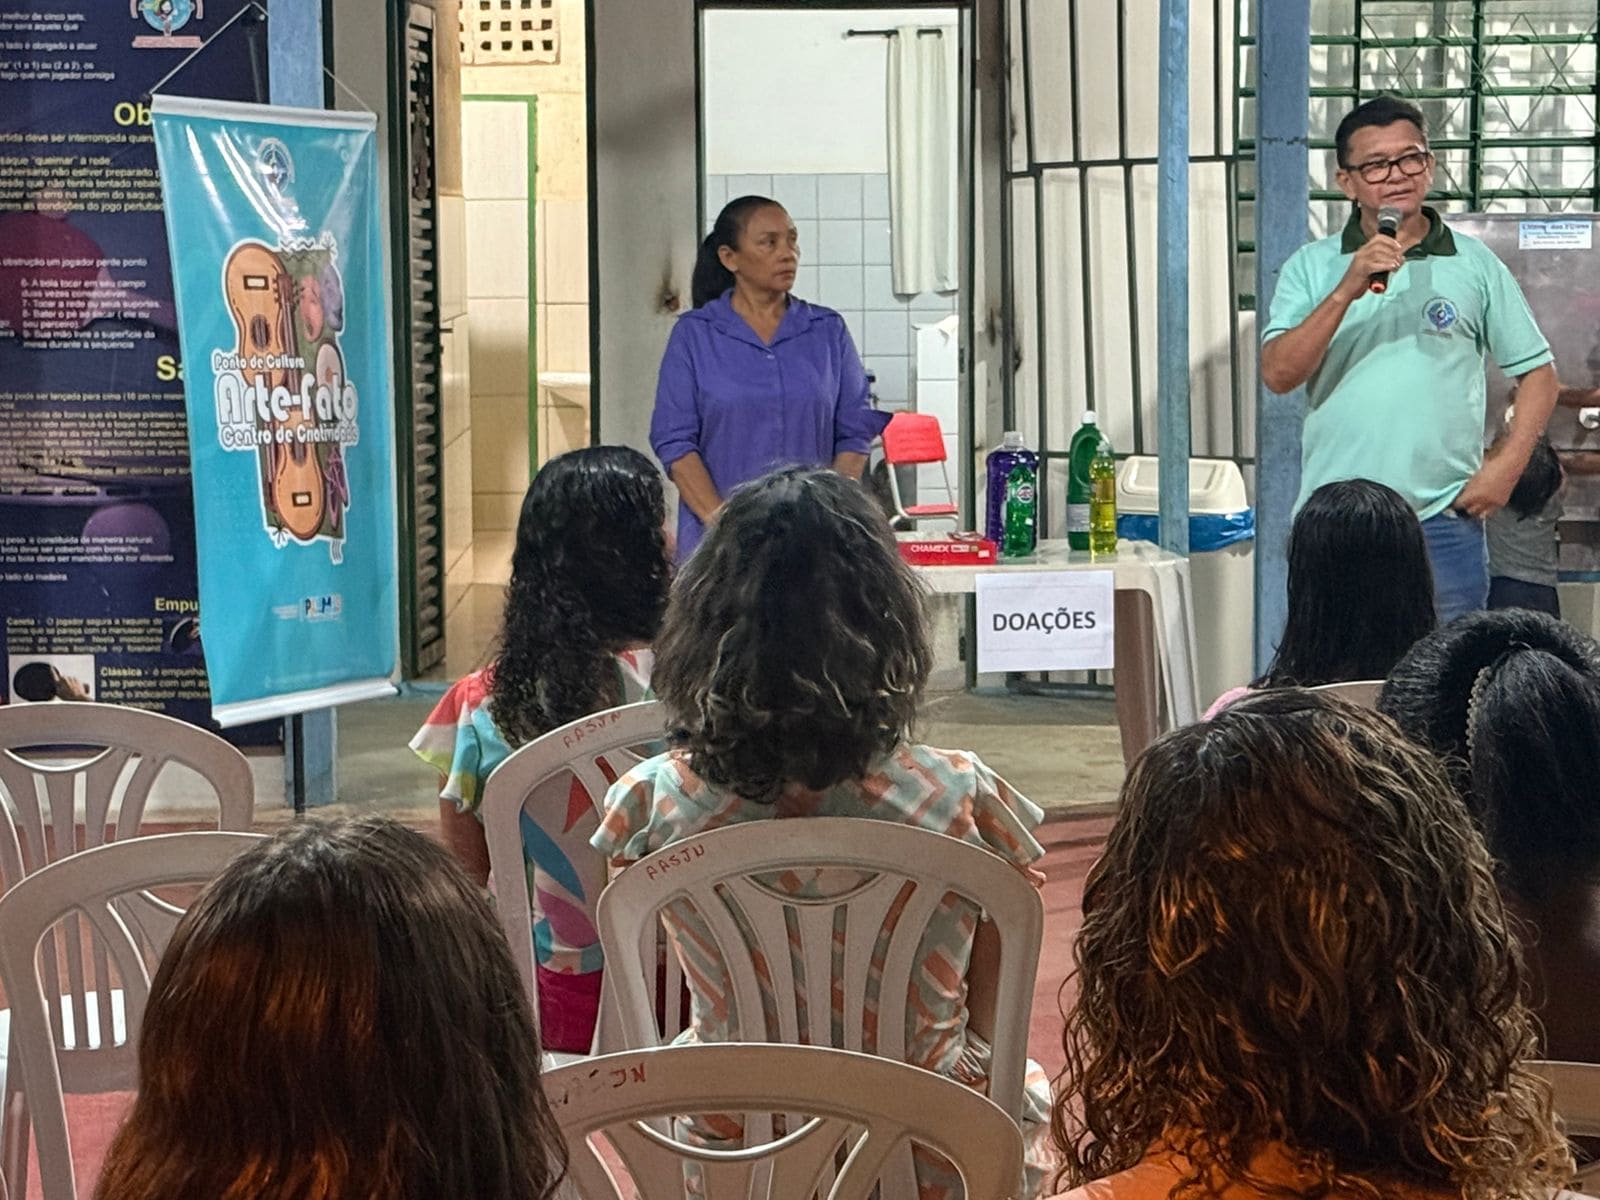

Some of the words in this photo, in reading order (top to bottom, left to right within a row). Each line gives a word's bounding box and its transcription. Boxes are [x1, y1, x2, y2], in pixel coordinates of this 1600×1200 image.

[112, 191, 125, 200] do
[86, 202, 100, 212] do
[101, 203, 121, 213] jogo
[214, 355, 247, 370] Ponto
[250, 354, 264, 368] de
[266, 353, 305, 369] Cultura
[221, 425, 272, 447] Centro
[275, 425, 293, 443] de
[911, 544, 949, 552] CHAMEX
[155, 598, 198, 613] Empu
[993, 607, 1096, 634] DOAÇÕES
